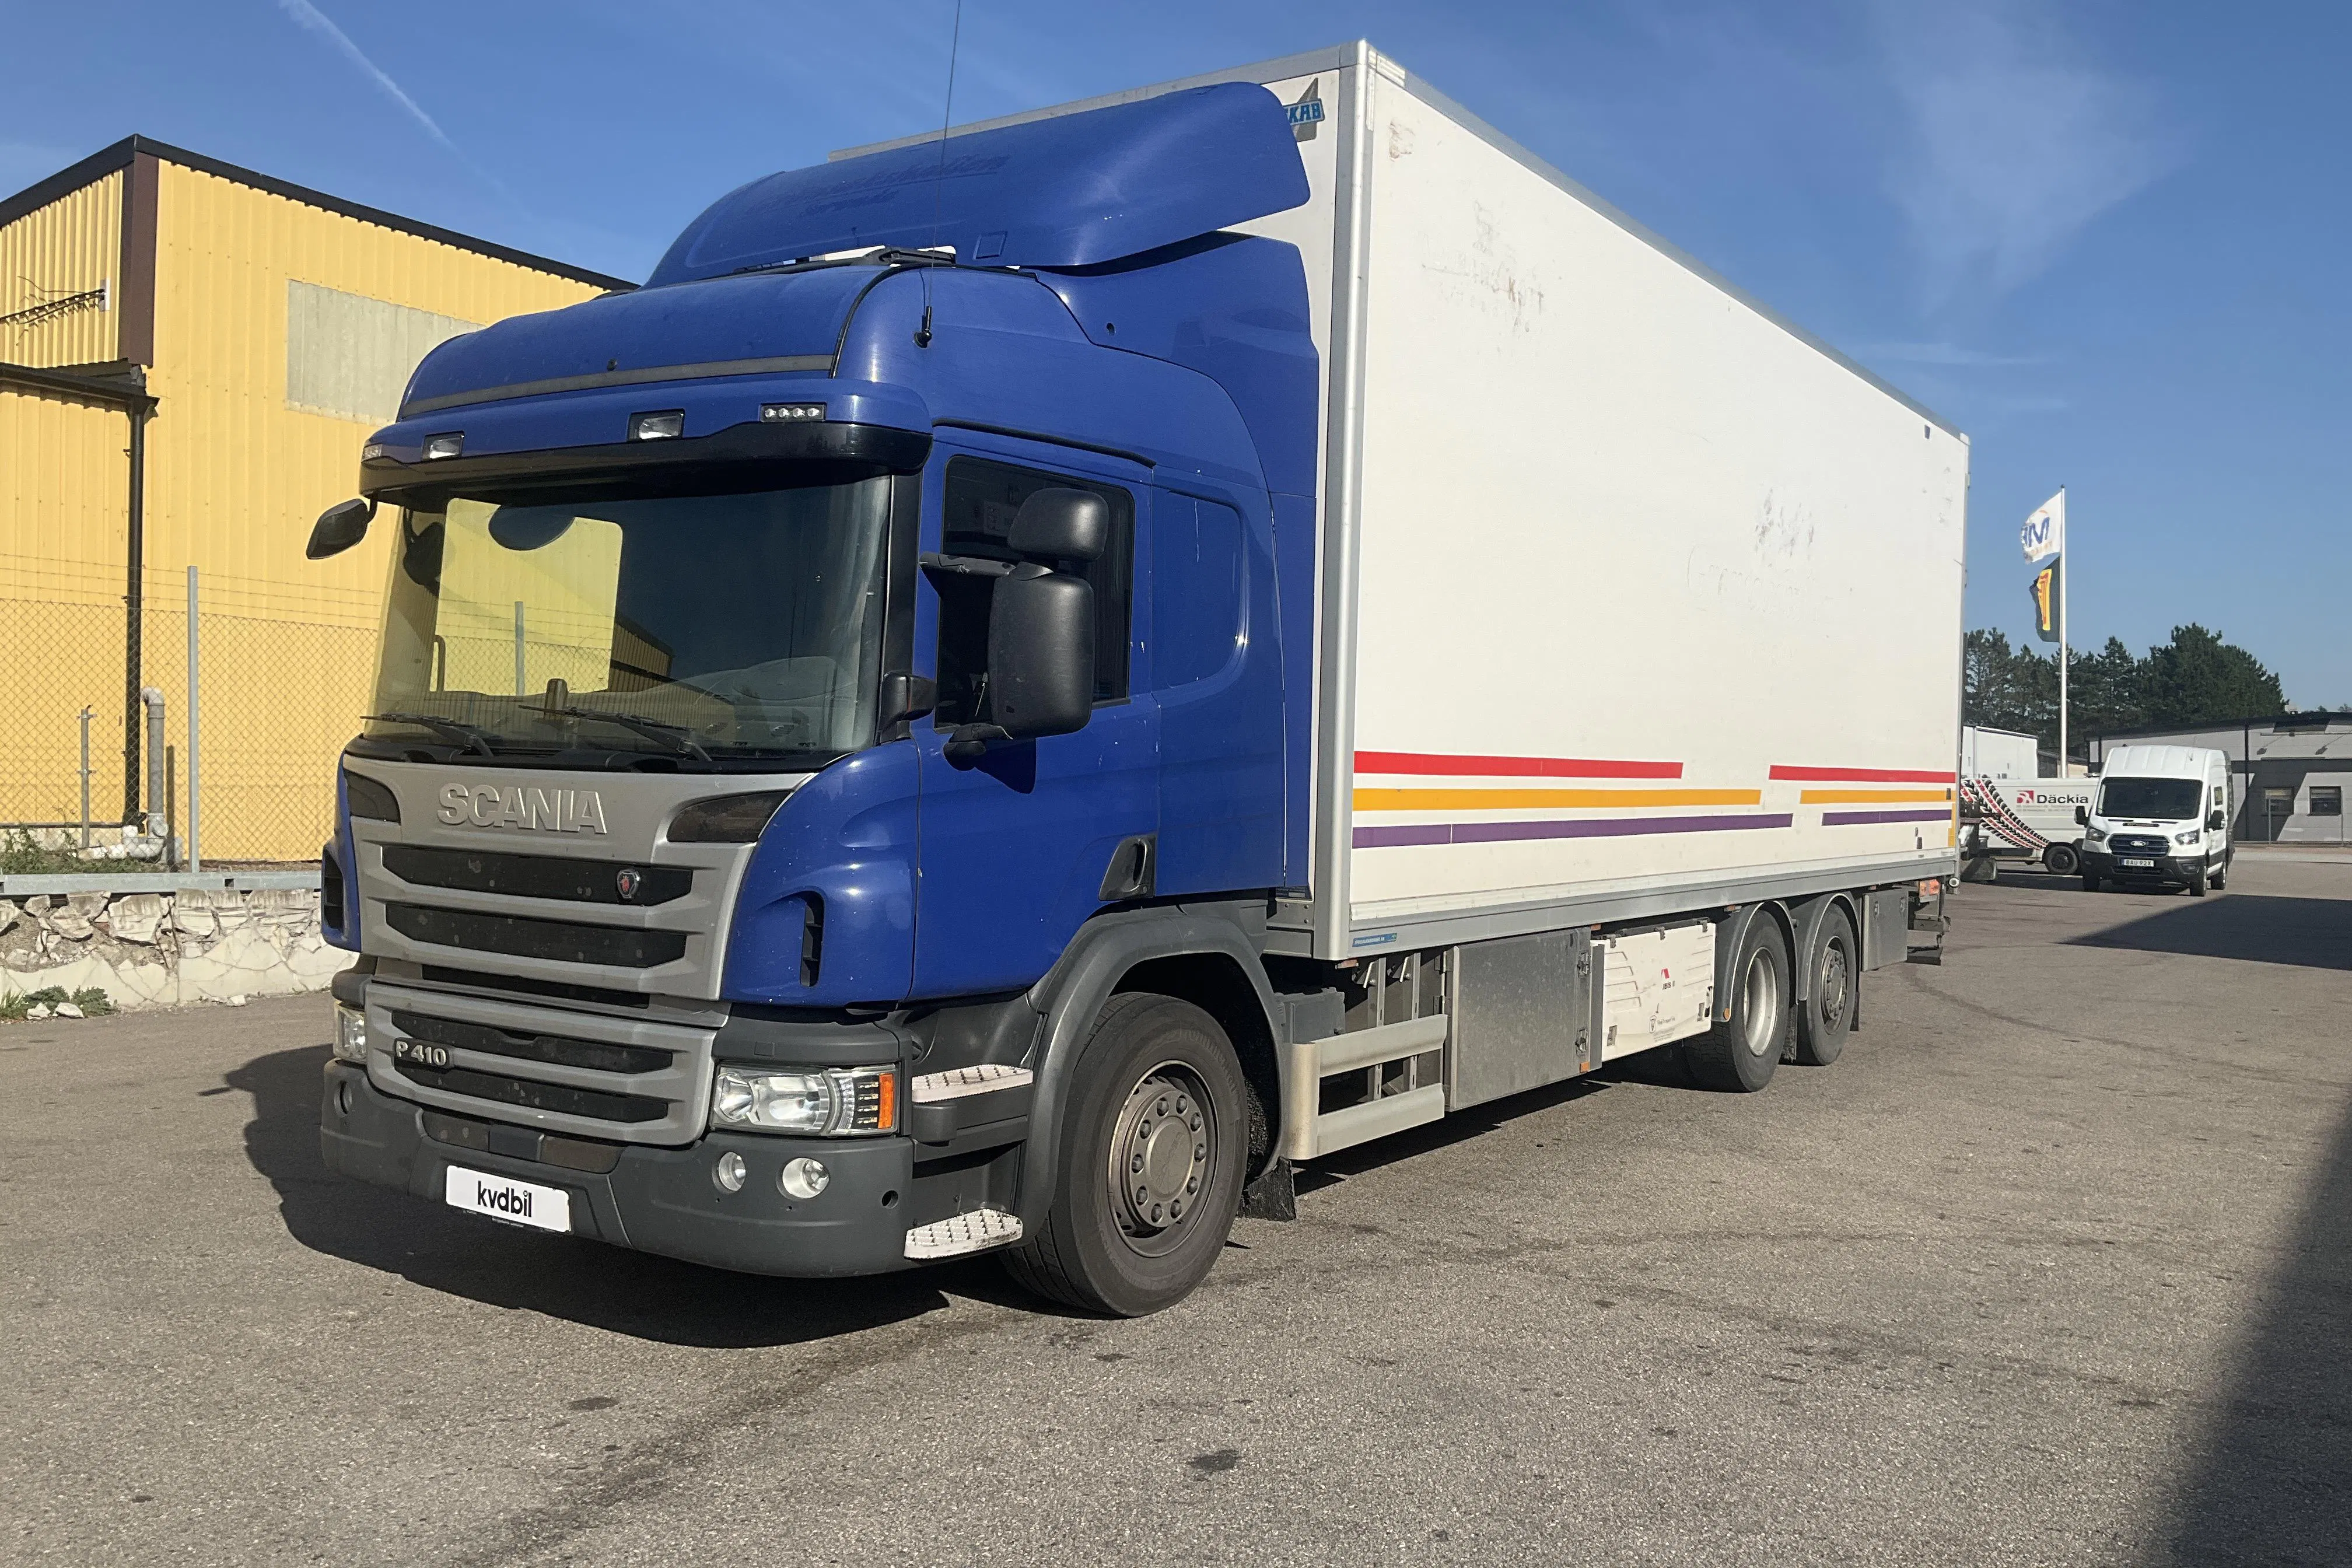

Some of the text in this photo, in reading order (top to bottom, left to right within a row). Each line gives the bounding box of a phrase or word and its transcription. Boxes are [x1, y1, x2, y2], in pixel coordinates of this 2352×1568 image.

[1286, 102, 1321, 123] KAB
[438, 783, 607, 834] SCANIA
[2037, 794, 2088, 804] Däckia
[396, 1041, 446, 1066] P 410
[477, 1180, 532, 1217] kvdbil
